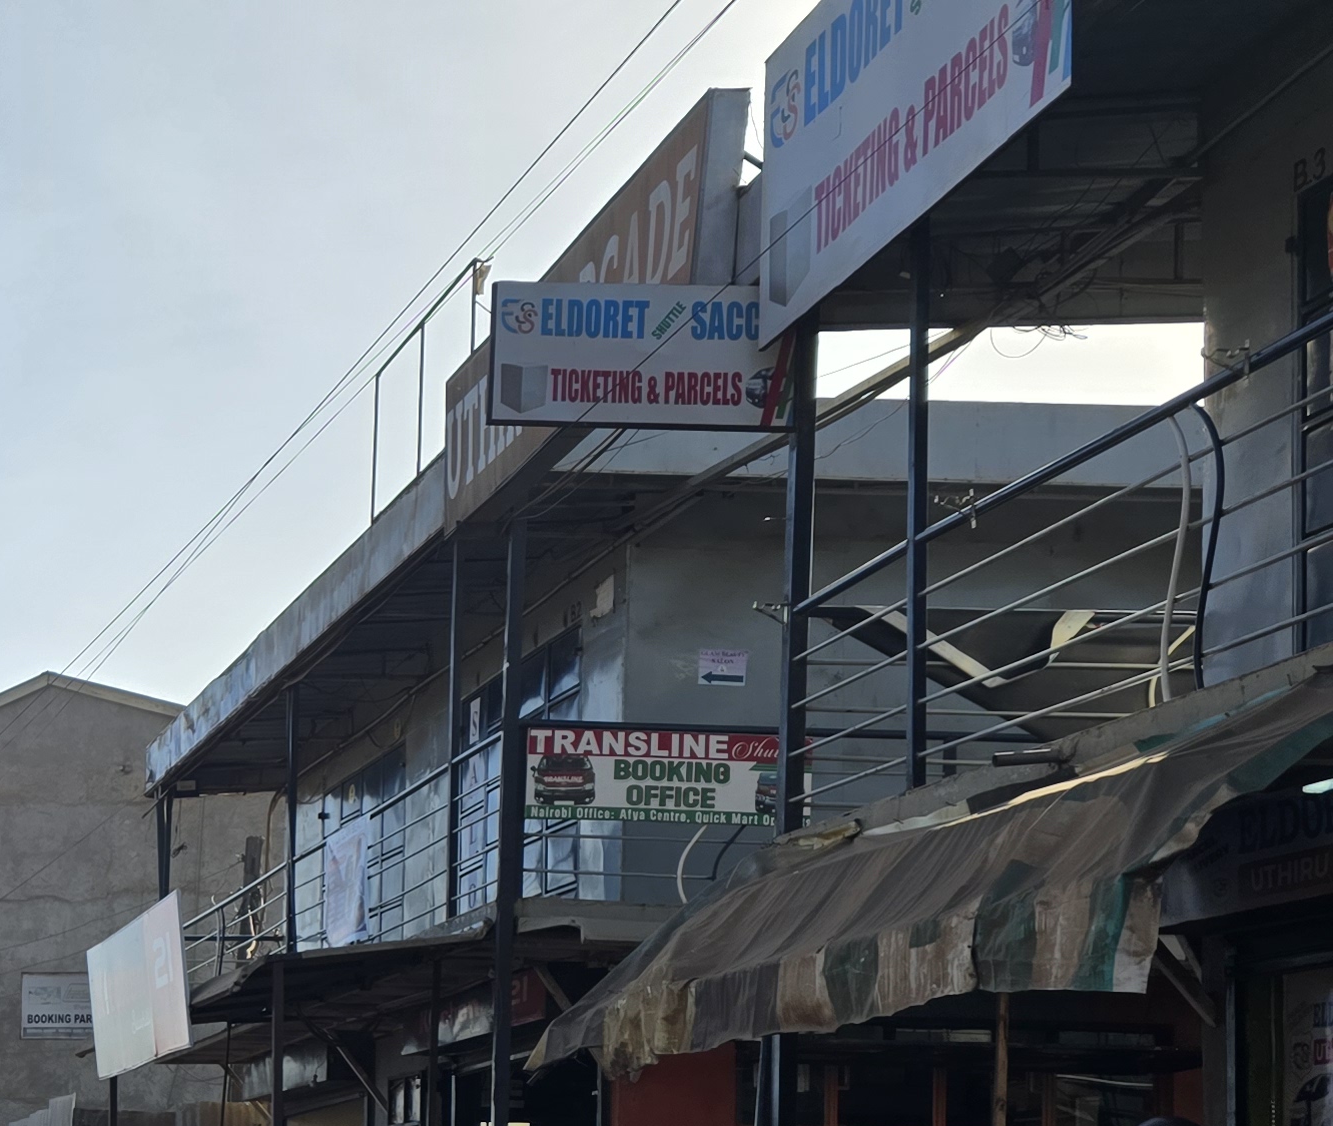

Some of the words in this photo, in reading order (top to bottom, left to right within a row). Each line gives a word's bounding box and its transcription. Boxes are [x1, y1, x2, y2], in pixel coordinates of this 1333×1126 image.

[814, 107, 900, 255] TICKETING
[903, 104, 918, 173] &
[922, 4, 1009, 158] PARCELS
[540, 298, 650, 339] ELDORET
[651, 300, 687, 341] SHUTTLE
[691, 301, 760, 341] SACC
[551, 368, 642, 404] TICKETING
[647, 375, 660, 405] &
[665, 371, 743, 406] PARCELS
[530, 729, 729, 759] TRANSLINE
[614, 759, 730, 784] BOOKING
[626, 785, 715, 809] OFFICE
[531, 806, 572, 819] Nairobi
[576, 807, 615, 820] Office:
[620, 810, 645, 823] Afya
[695, 812, 729, 825] Quick
[731, 813, 759, 826] Mart
[27, 1014, 71, 1024] BOOKING
